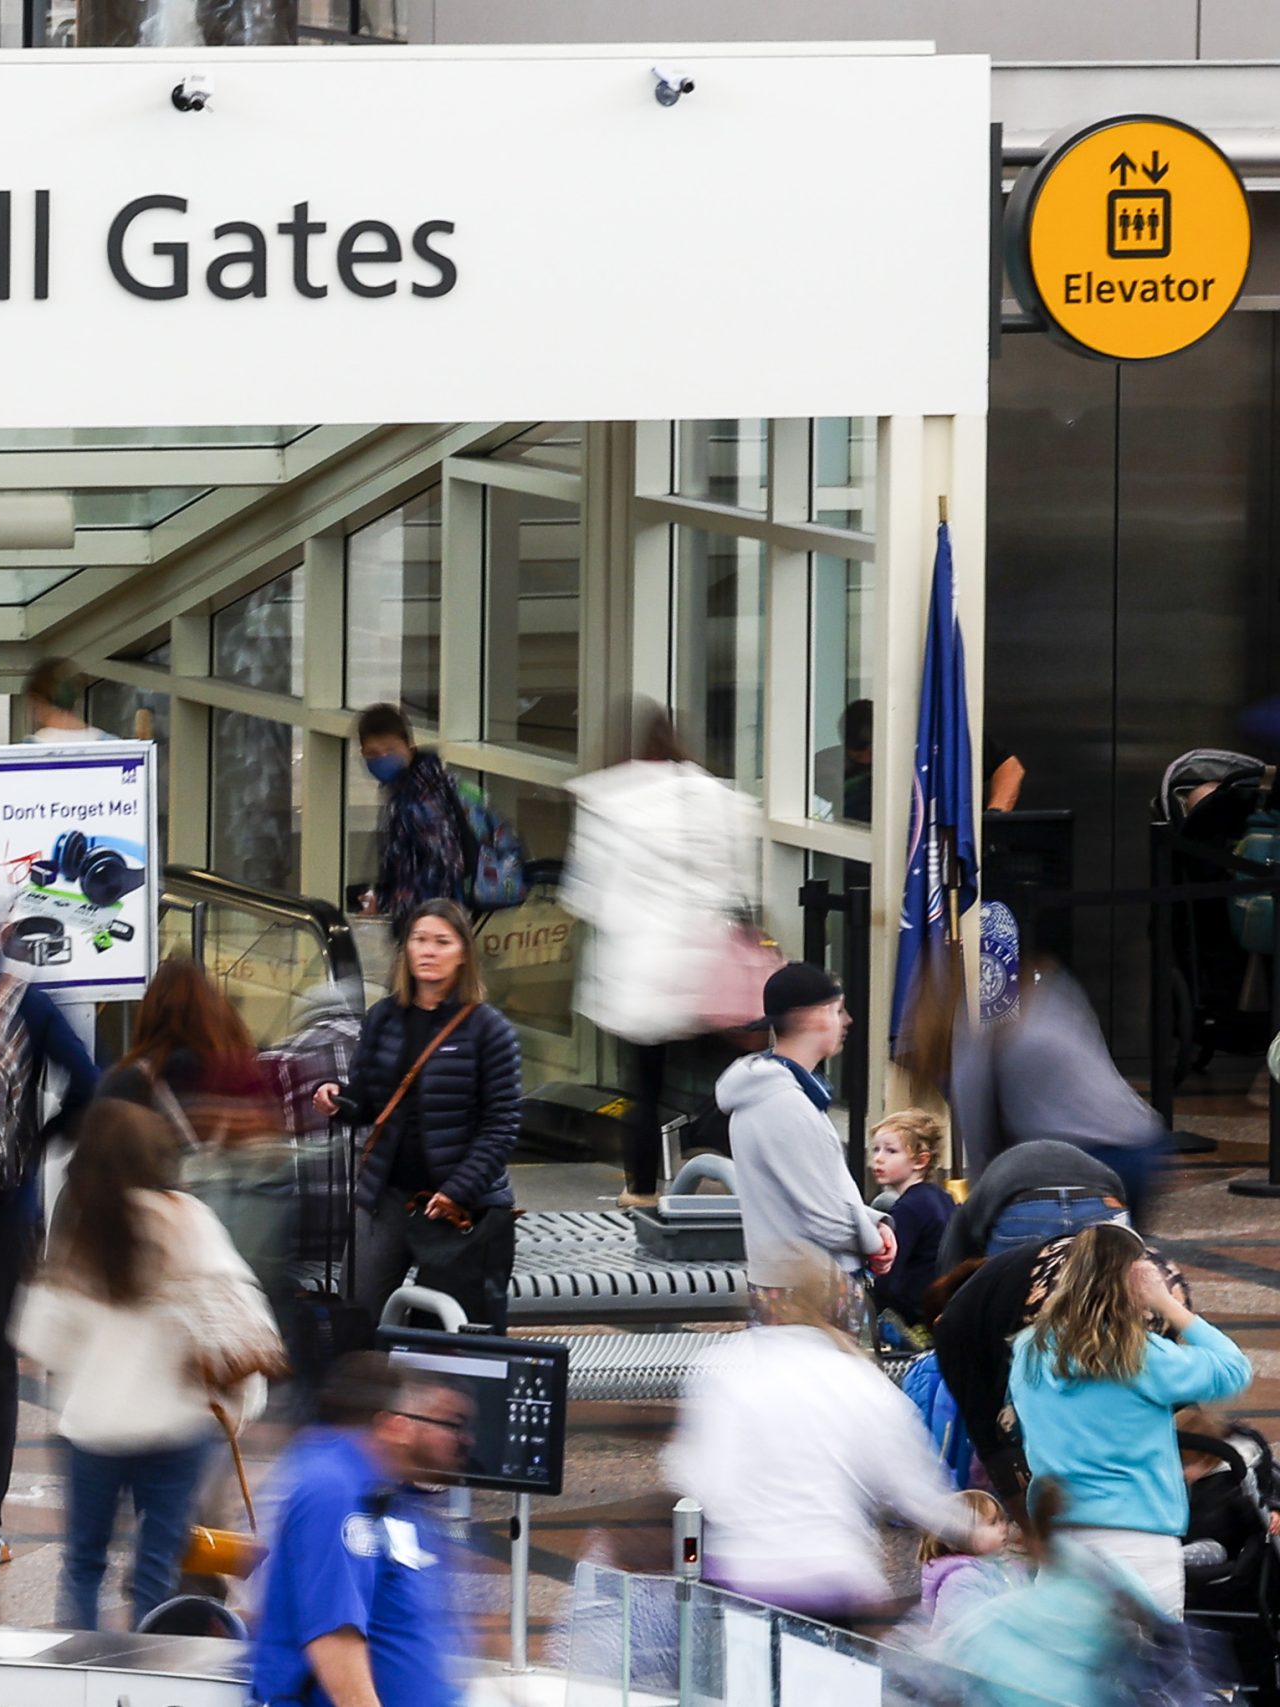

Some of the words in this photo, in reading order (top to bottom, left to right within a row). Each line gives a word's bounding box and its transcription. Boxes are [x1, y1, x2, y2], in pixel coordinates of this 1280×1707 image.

[106, 193, 458, 303] Gates
[1064, 271, 1216, 304] Elevator
[2, 804, 46, 821] Don't
[50, 801, 104, 821] Forget
[108, 800, 138, 816] Me!
